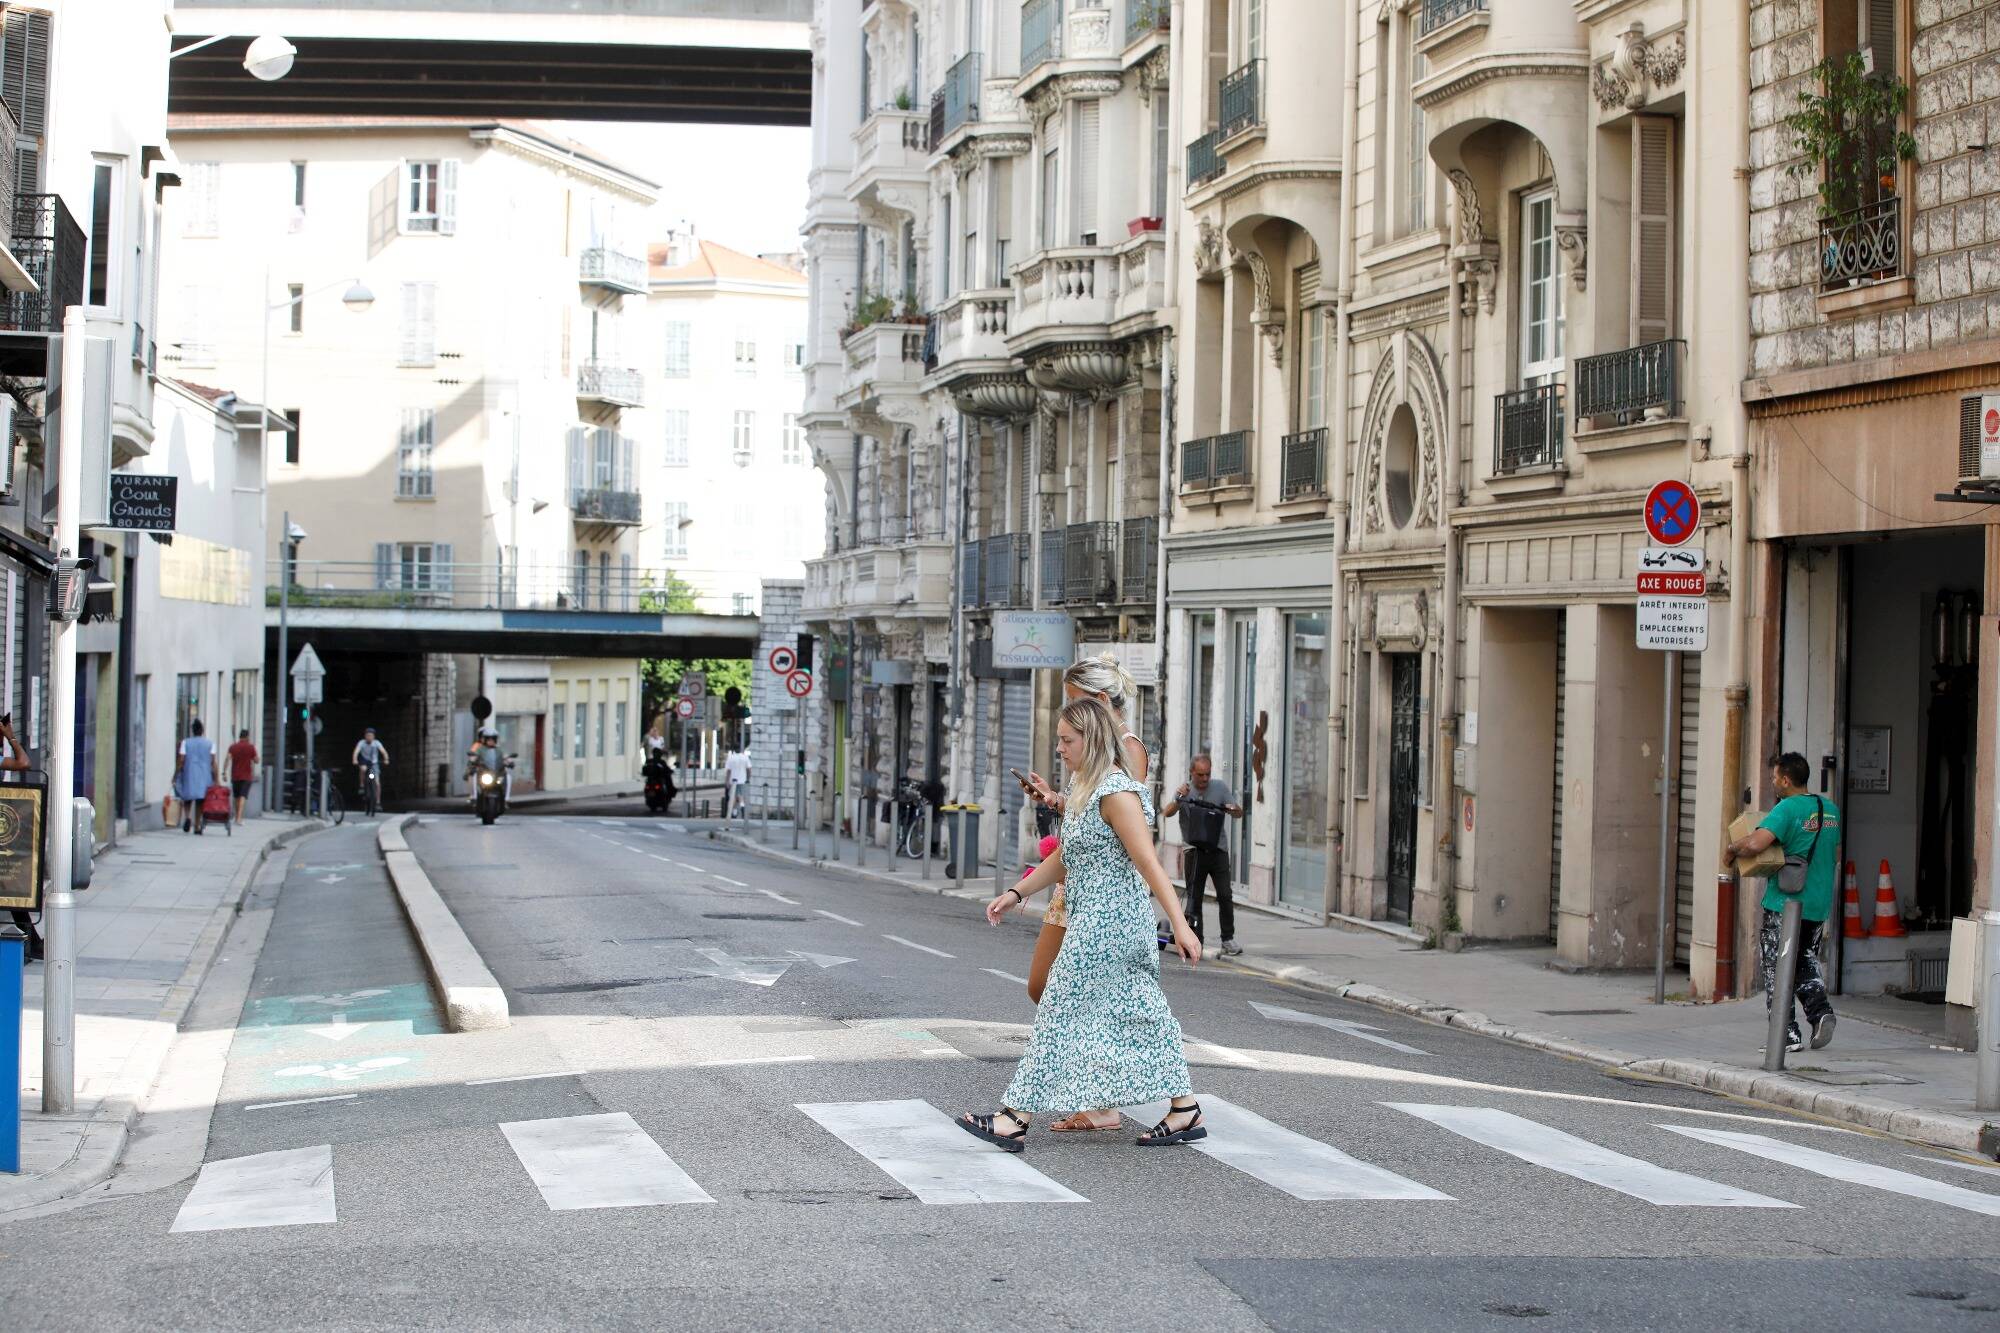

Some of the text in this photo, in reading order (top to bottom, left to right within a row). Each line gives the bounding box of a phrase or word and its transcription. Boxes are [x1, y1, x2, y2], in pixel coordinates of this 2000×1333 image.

[120, 486, 160, 500] Cour
[112, 500, 172, 517] Grands
[117, 519, 133, 527] 80
[137, 520, 151, 528] 74
[156, 520, 171, 528] 02
[1640, 578, 1702, 590] AXE ROUGE
[1640, 600, 1706, 610] ARRÊT INTERDIT
[1661, 613, 1683, 621] HORS
[1639, 624, 1705, 634] EMPLACEMENTS
[1649, 635, 1694, 645] AUTORISÉS
[1000, 654, 1066, 664] assurances
